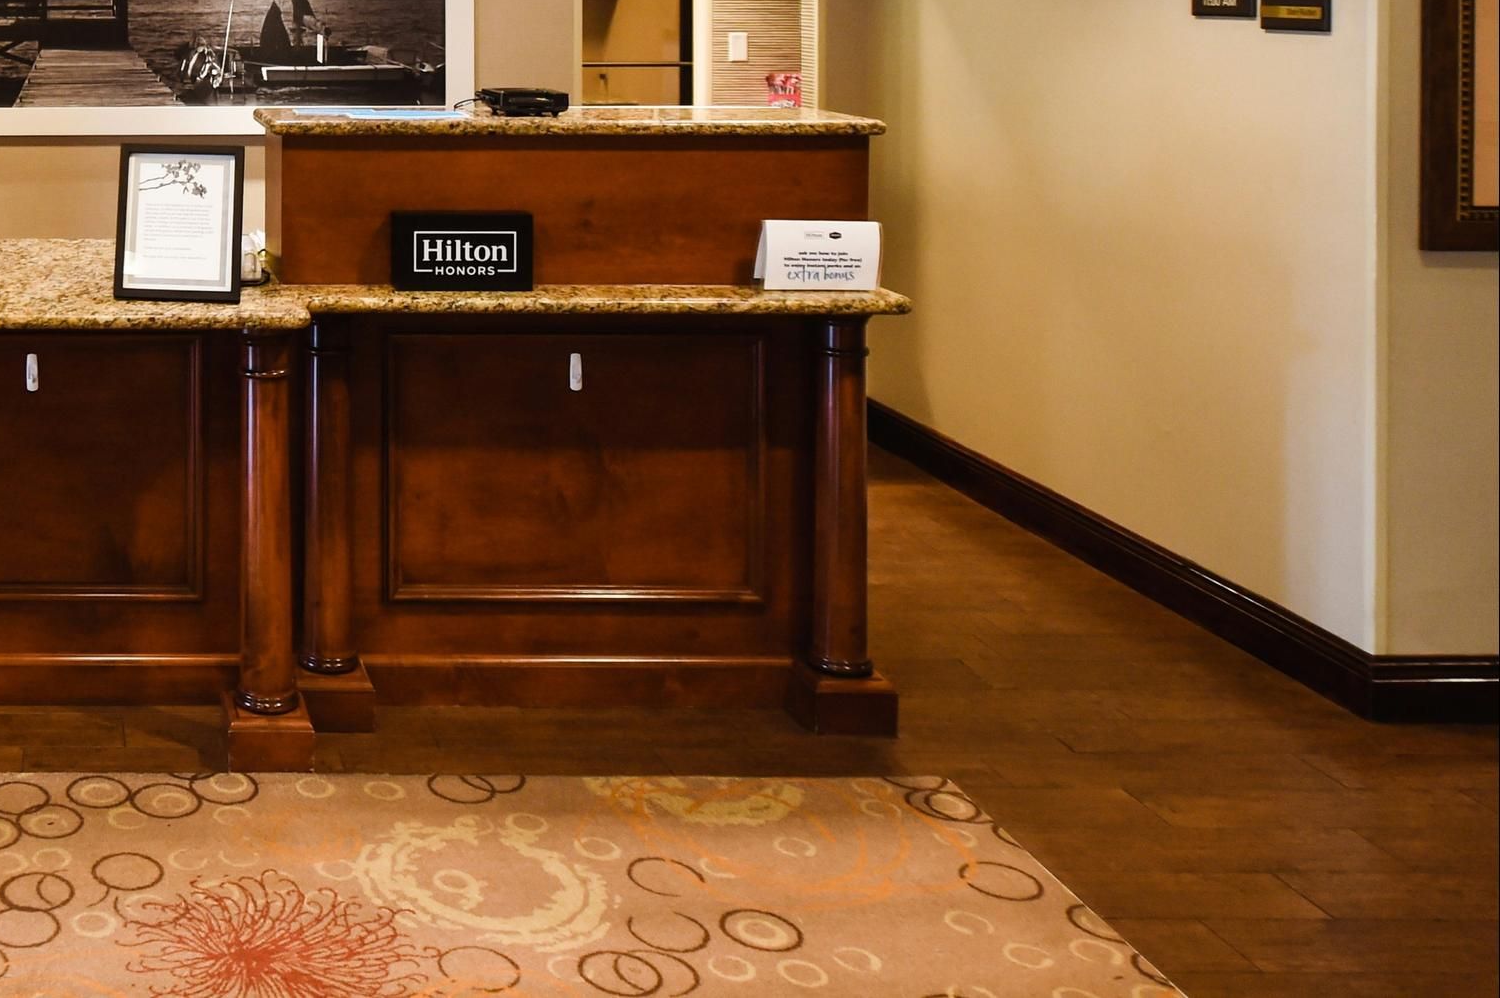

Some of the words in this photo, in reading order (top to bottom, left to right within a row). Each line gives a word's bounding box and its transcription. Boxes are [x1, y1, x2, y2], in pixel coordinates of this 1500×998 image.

[422, 239, 508, 262] Hilton
[435, 266, 496, 276] HONORS
[787, 266, 821, 282] extra
[823, 266, 855, 281] bonus
